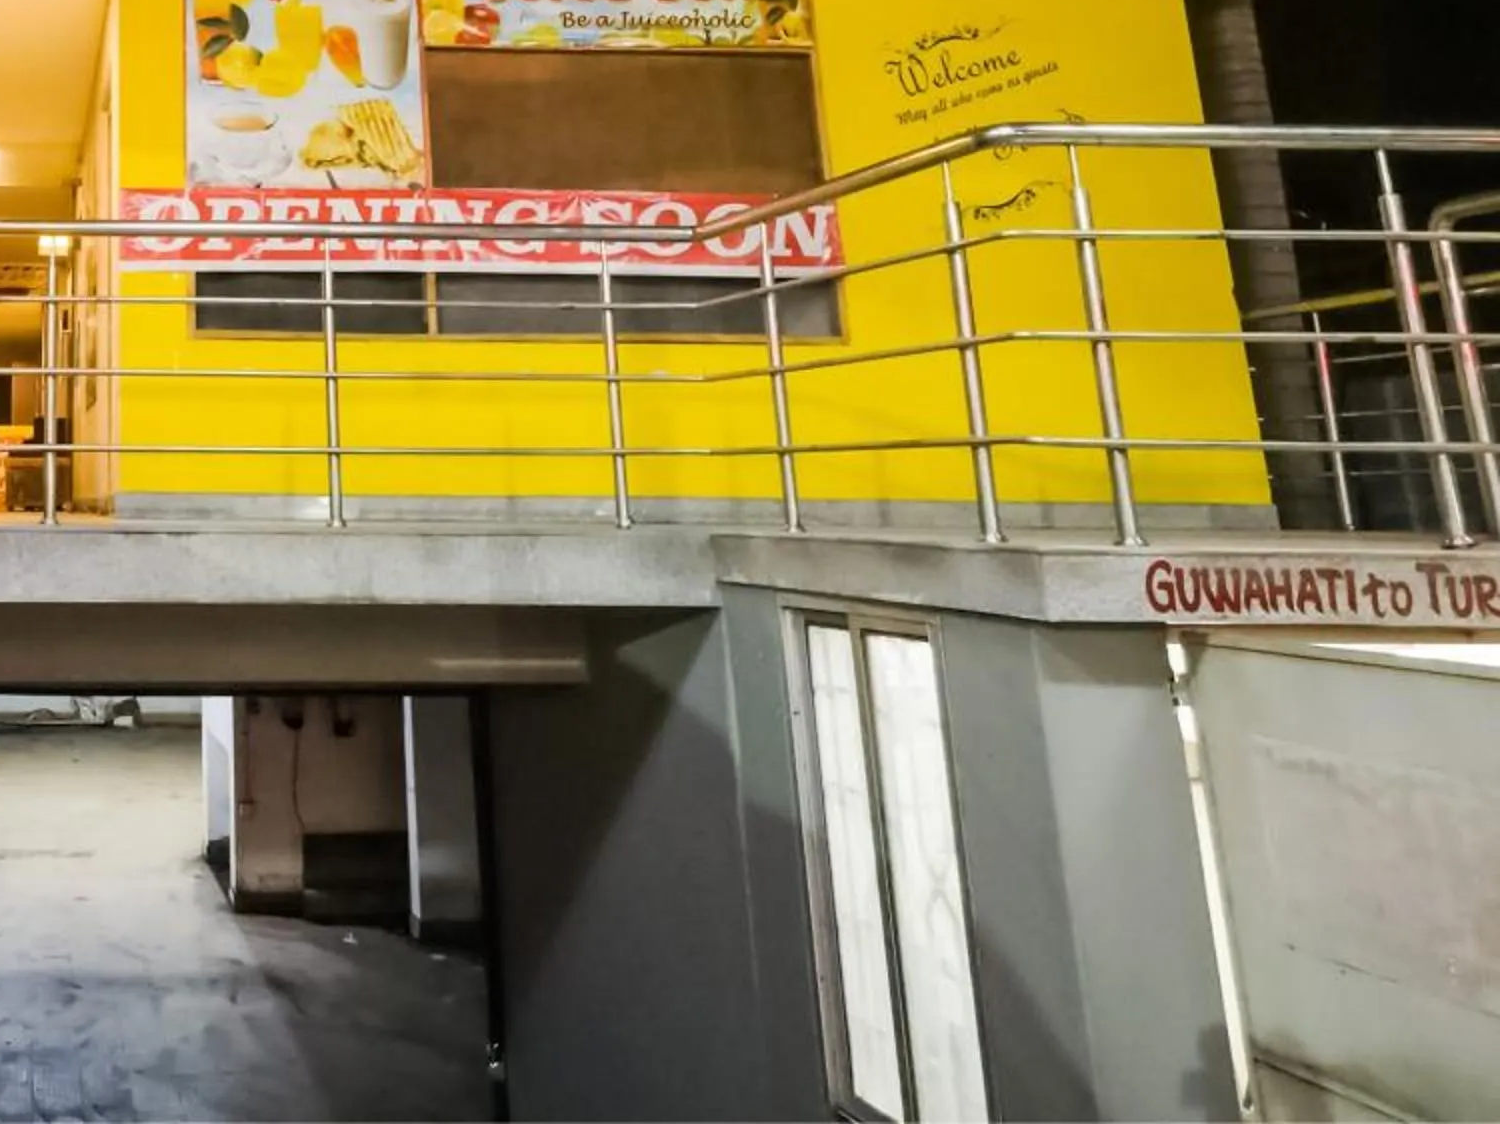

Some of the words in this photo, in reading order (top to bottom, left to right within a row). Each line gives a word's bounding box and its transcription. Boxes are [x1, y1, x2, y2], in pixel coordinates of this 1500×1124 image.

[560, 10, 592, 28] Be
[596, 15, 614, 27] a
[614, 8, 756, 31] Juiceoholic
[885, 48, 1022, 97] Welcome
[137, 196, 551, 255] OPENING
[579, 199, 836, 258] SOON
[1146, 560, 1358, 614] GUWAHATI
[1362, 573, 1413, 617] to
